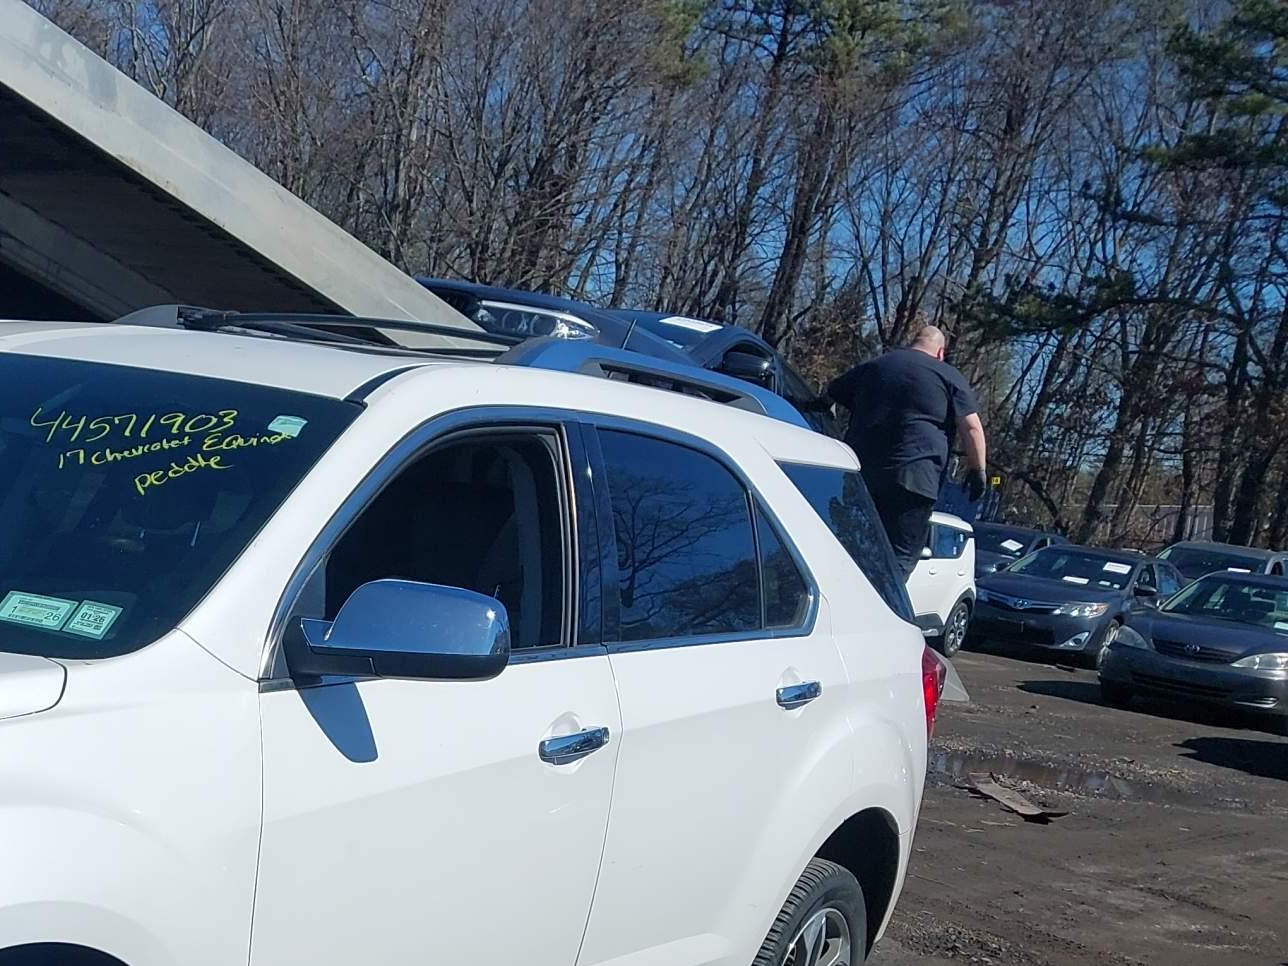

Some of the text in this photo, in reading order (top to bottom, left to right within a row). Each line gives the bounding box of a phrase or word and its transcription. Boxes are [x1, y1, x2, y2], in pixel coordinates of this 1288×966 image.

[30, 407, 239, 443] 44571903
[58, 449, 84, 469] 17
[44, 611, 61, 621] 26
